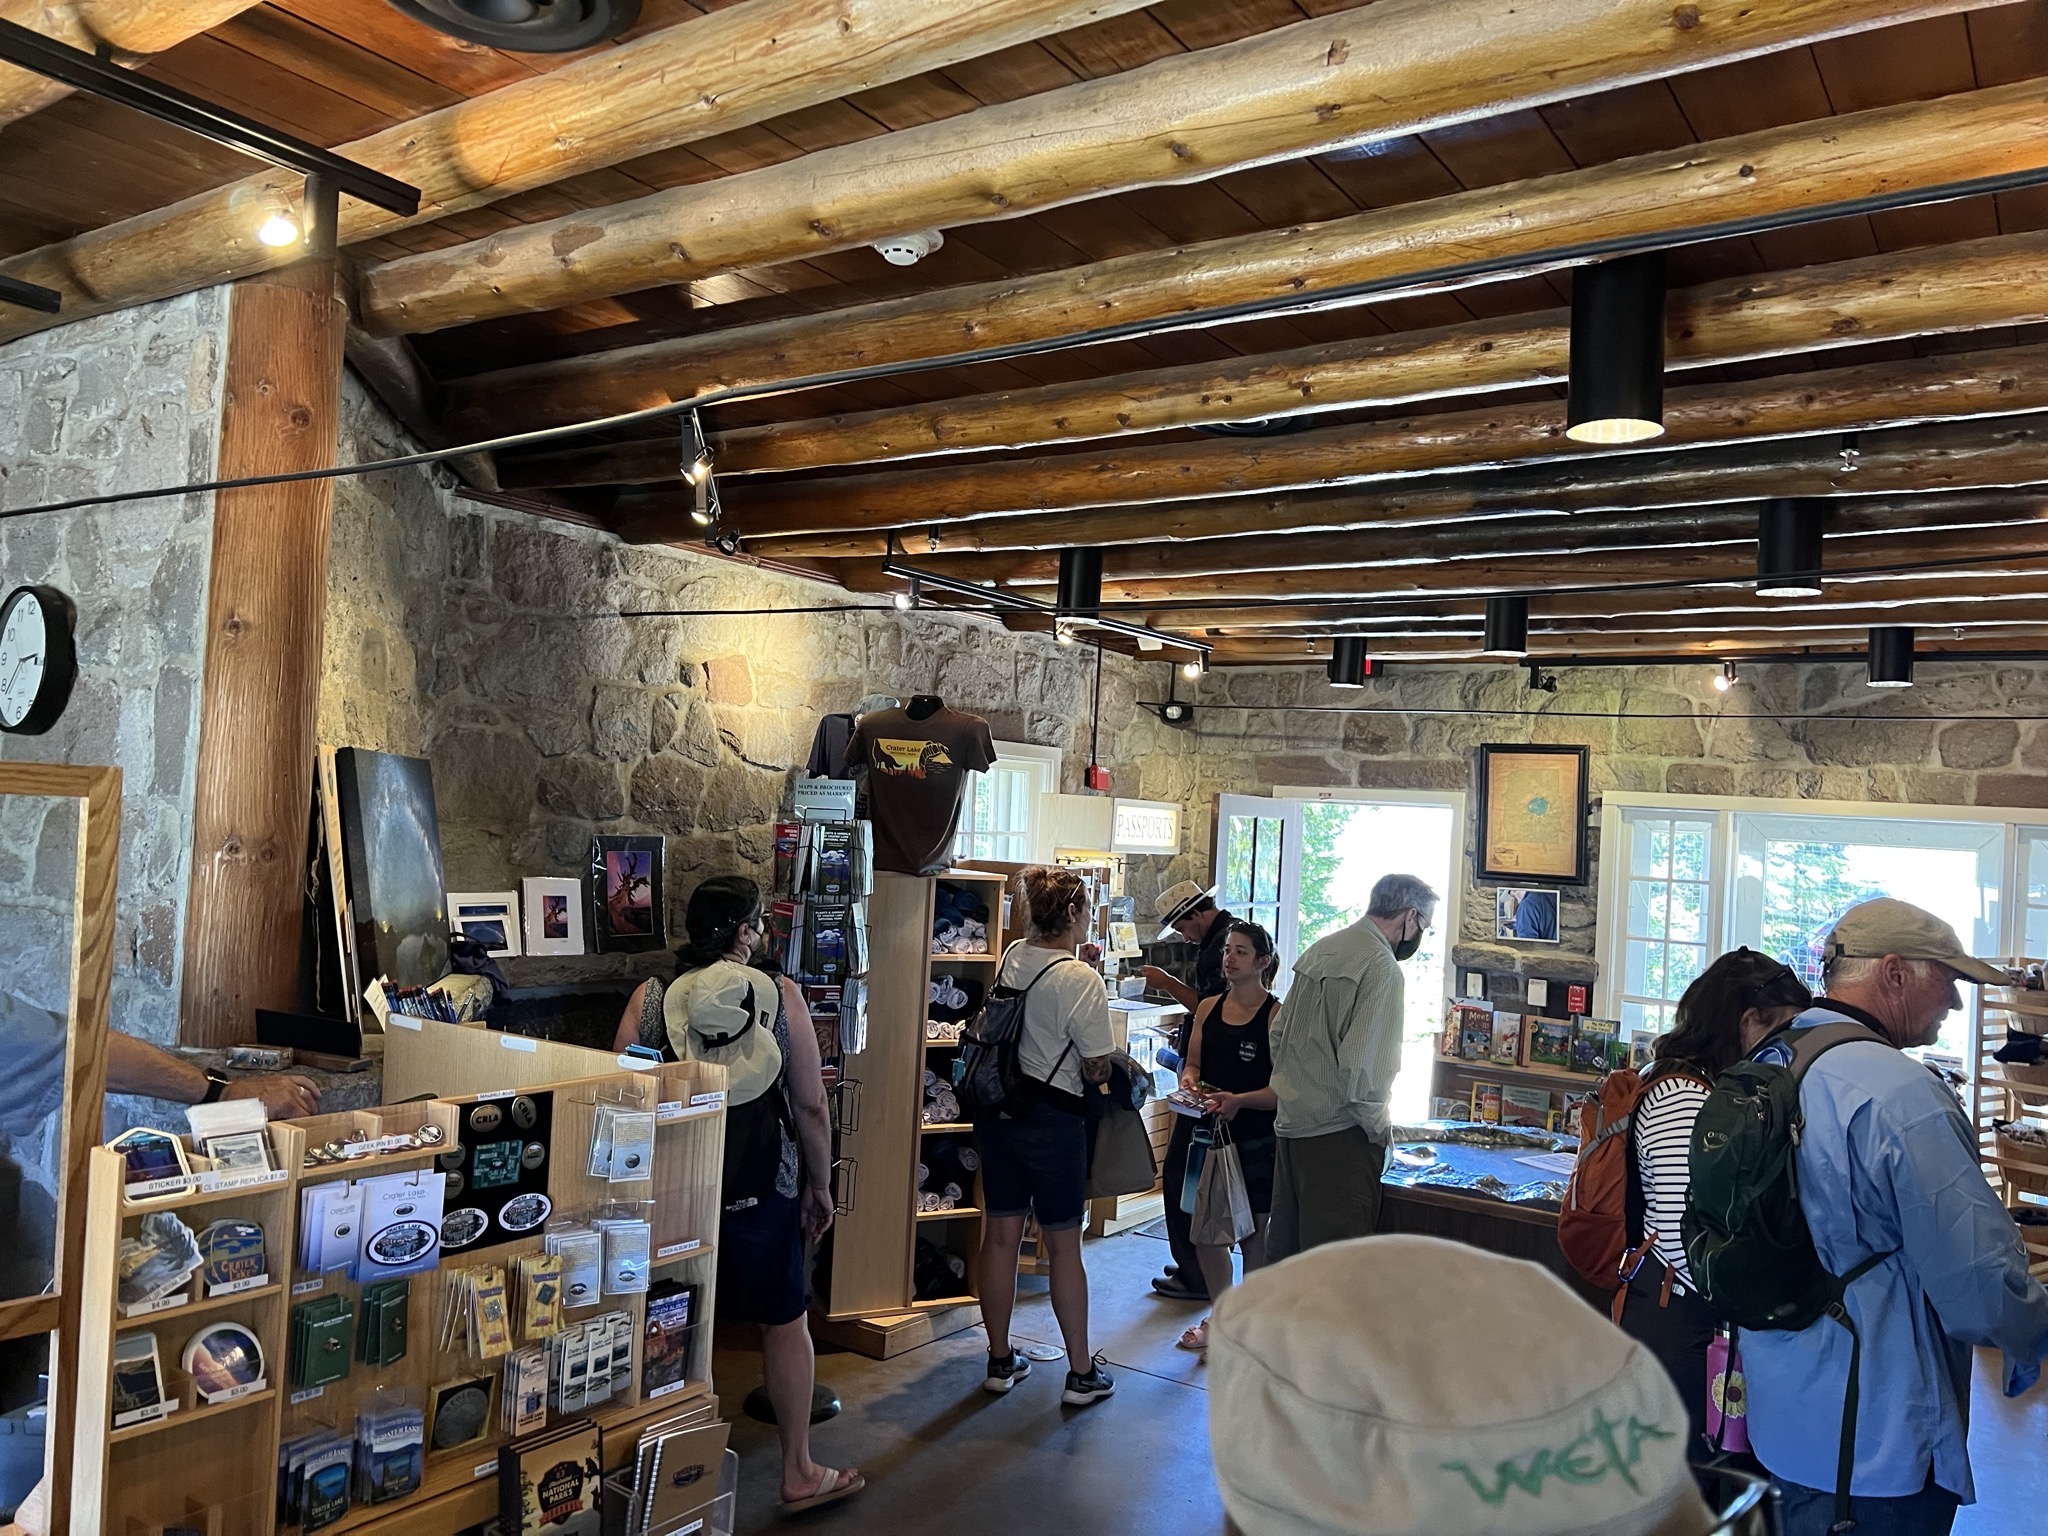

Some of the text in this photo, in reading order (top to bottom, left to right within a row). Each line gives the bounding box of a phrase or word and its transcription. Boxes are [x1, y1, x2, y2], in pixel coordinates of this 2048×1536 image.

[18, 608, 24, 622] 11
[28, 601, 36, 615] 12
[7, 628, 15, 642] 10
[1, 652, 7, 666] 9
[1, 678, 7, 692] 8
[7, 698, 12, 712] 7
[16, 706, 22, 720] 6
[886, 744, 905, 752] Crater
[1117, 814, 1174, 840] PASSPORTS
[1468, 1011, 1490, 1021] Meet
[475, 1113, 499, 1124] CRLA
[518, 1101, 533, 1125] CRLA
[358, 1138, 402, 1151] GEEK PIN $1.00
[148, 1175, 201, 1190] STICKER $3.00
[215, 1180, 238, 1189] STAMP
[240, 1175, 269, 1185] REPLICA
[270, 1171, 287, 1181] $1.50
[382, 1188, 425, 1200] Crater Lake
[385, 1224, 405, 1235] CRATER
[232, 1280, 250, 1290] $3.99
[293, 1284, 304, 1292] PIN
[151, 1299, 171, 1310] $4.99
[650, 1306, 668, 1316] TOKEN
[230, 1385, 248, 1396] $3.00
[376, 1425, 421, 1444] CRATER LAKE
[542, 1478, 579, 1500] NATIONAL
[549, 1488, 573, 1504] PARKS
[311, 1496, 344, 1516] CRATER LAKE
